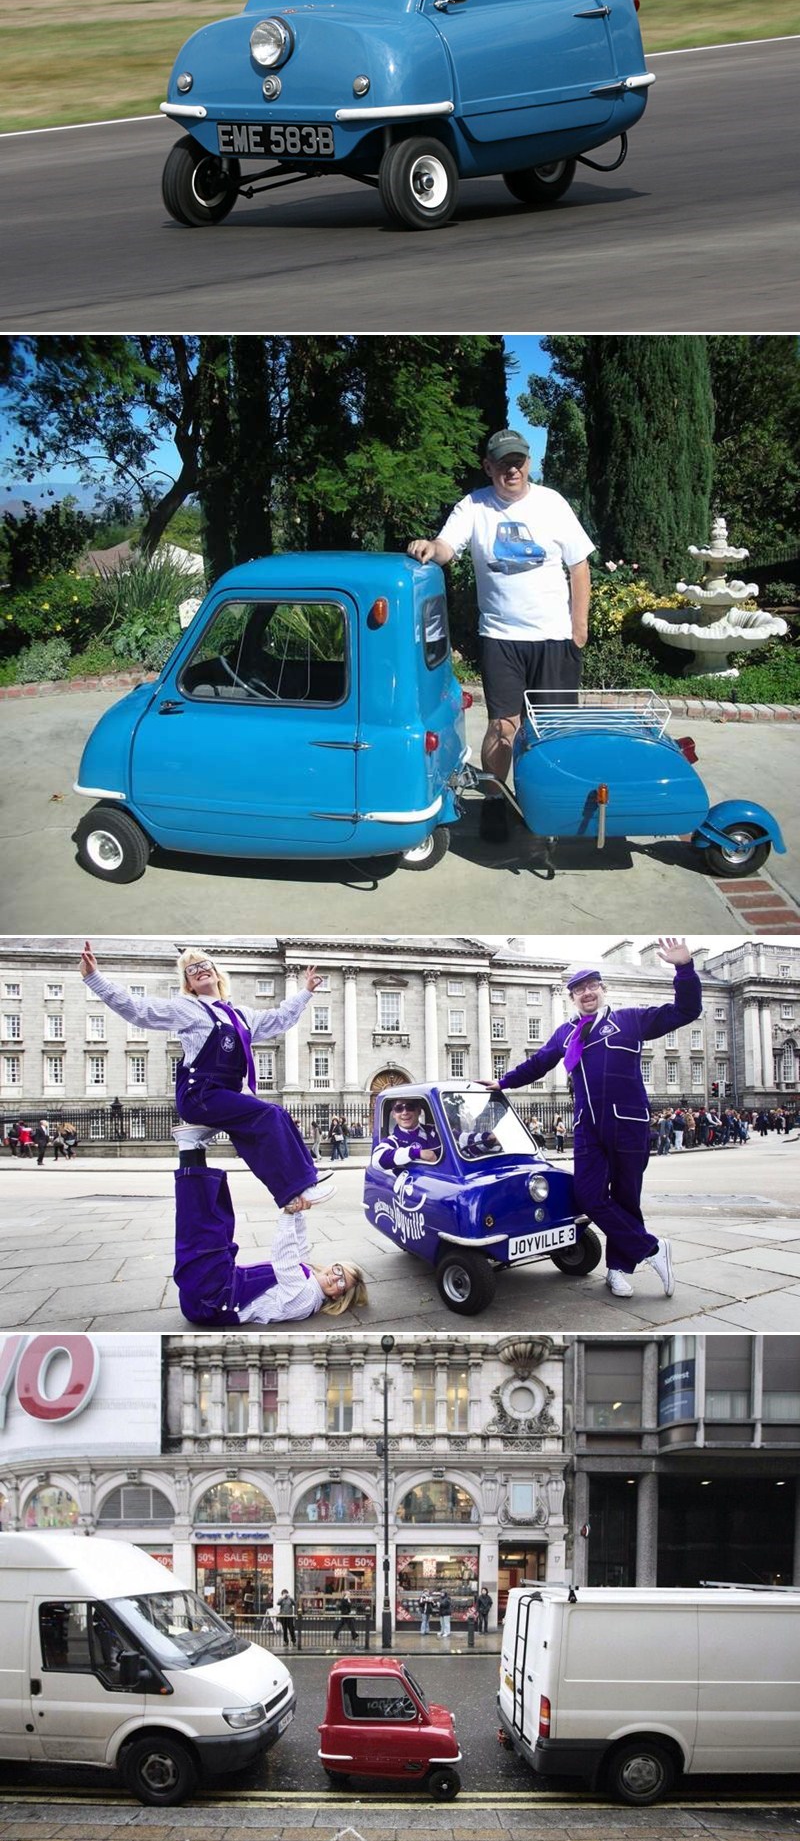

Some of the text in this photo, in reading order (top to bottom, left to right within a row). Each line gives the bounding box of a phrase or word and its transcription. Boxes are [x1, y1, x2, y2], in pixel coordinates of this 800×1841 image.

[217, 125, 334, 155] EME 583B
[510, 1231, 575, 1256] JOYVILLE 3
[223, 1552, 249, 1562] SALE
[298, 1557, 374, 1567] 50% SALE 50%
